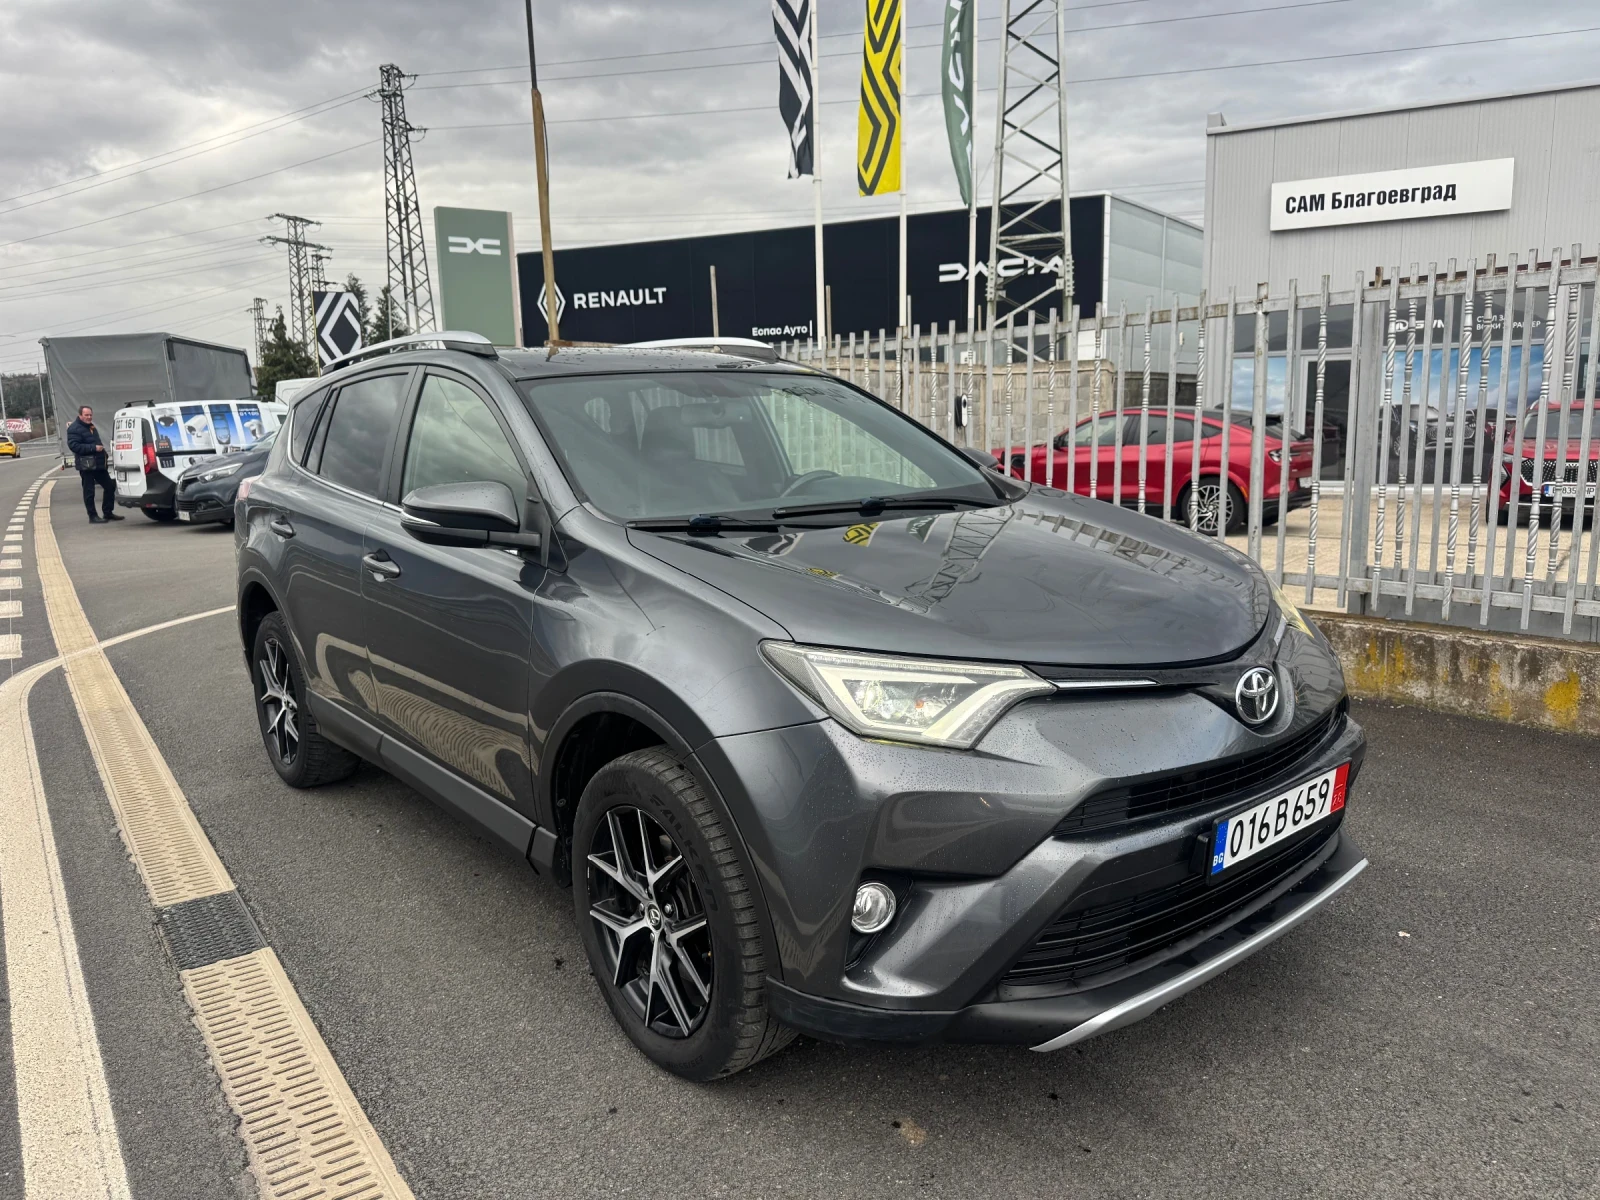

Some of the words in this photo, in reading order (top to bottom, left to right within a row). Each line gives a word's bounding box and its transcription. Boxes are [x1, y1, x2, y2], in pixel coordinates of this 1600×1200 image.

[1285, 194, 1325, 214] САМ
[1331, 183, 1457, 210] Благоевград
[573, 287, 667, 309] RENAULT
[752, 327, 782, 337] Еспас
[783, 325, 808, 337] Ауто
[125, 418, 135, 429] 161
[1212, 853, 1224, 867] BG
[1230, 778, 1330, 858] 016B659
[649, 794, 718, 912] FALKEN
